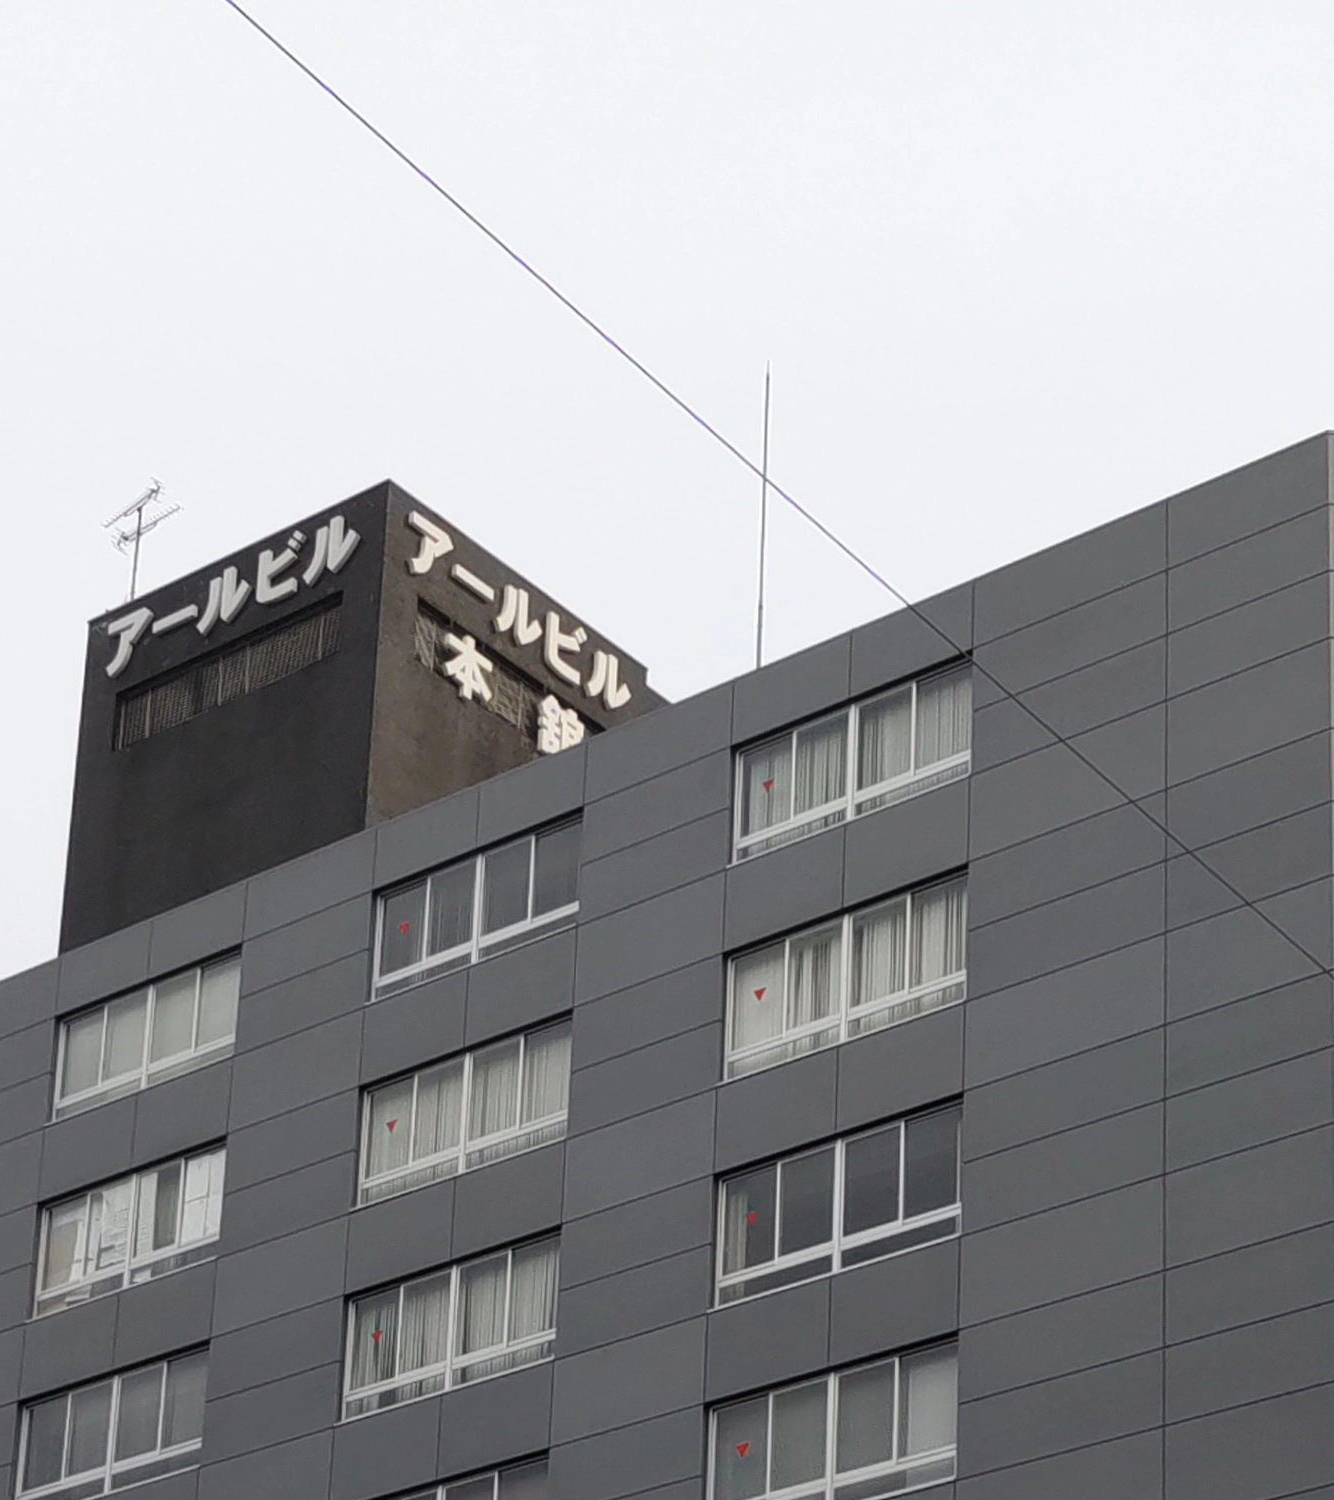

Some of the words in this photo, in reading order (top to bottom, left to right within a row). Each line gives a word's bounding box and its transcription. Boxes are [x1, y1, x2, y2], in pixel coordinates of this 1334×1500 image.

[105, 515, 361, 678] アールビル
[407, 511, 632, 711] アールビル
